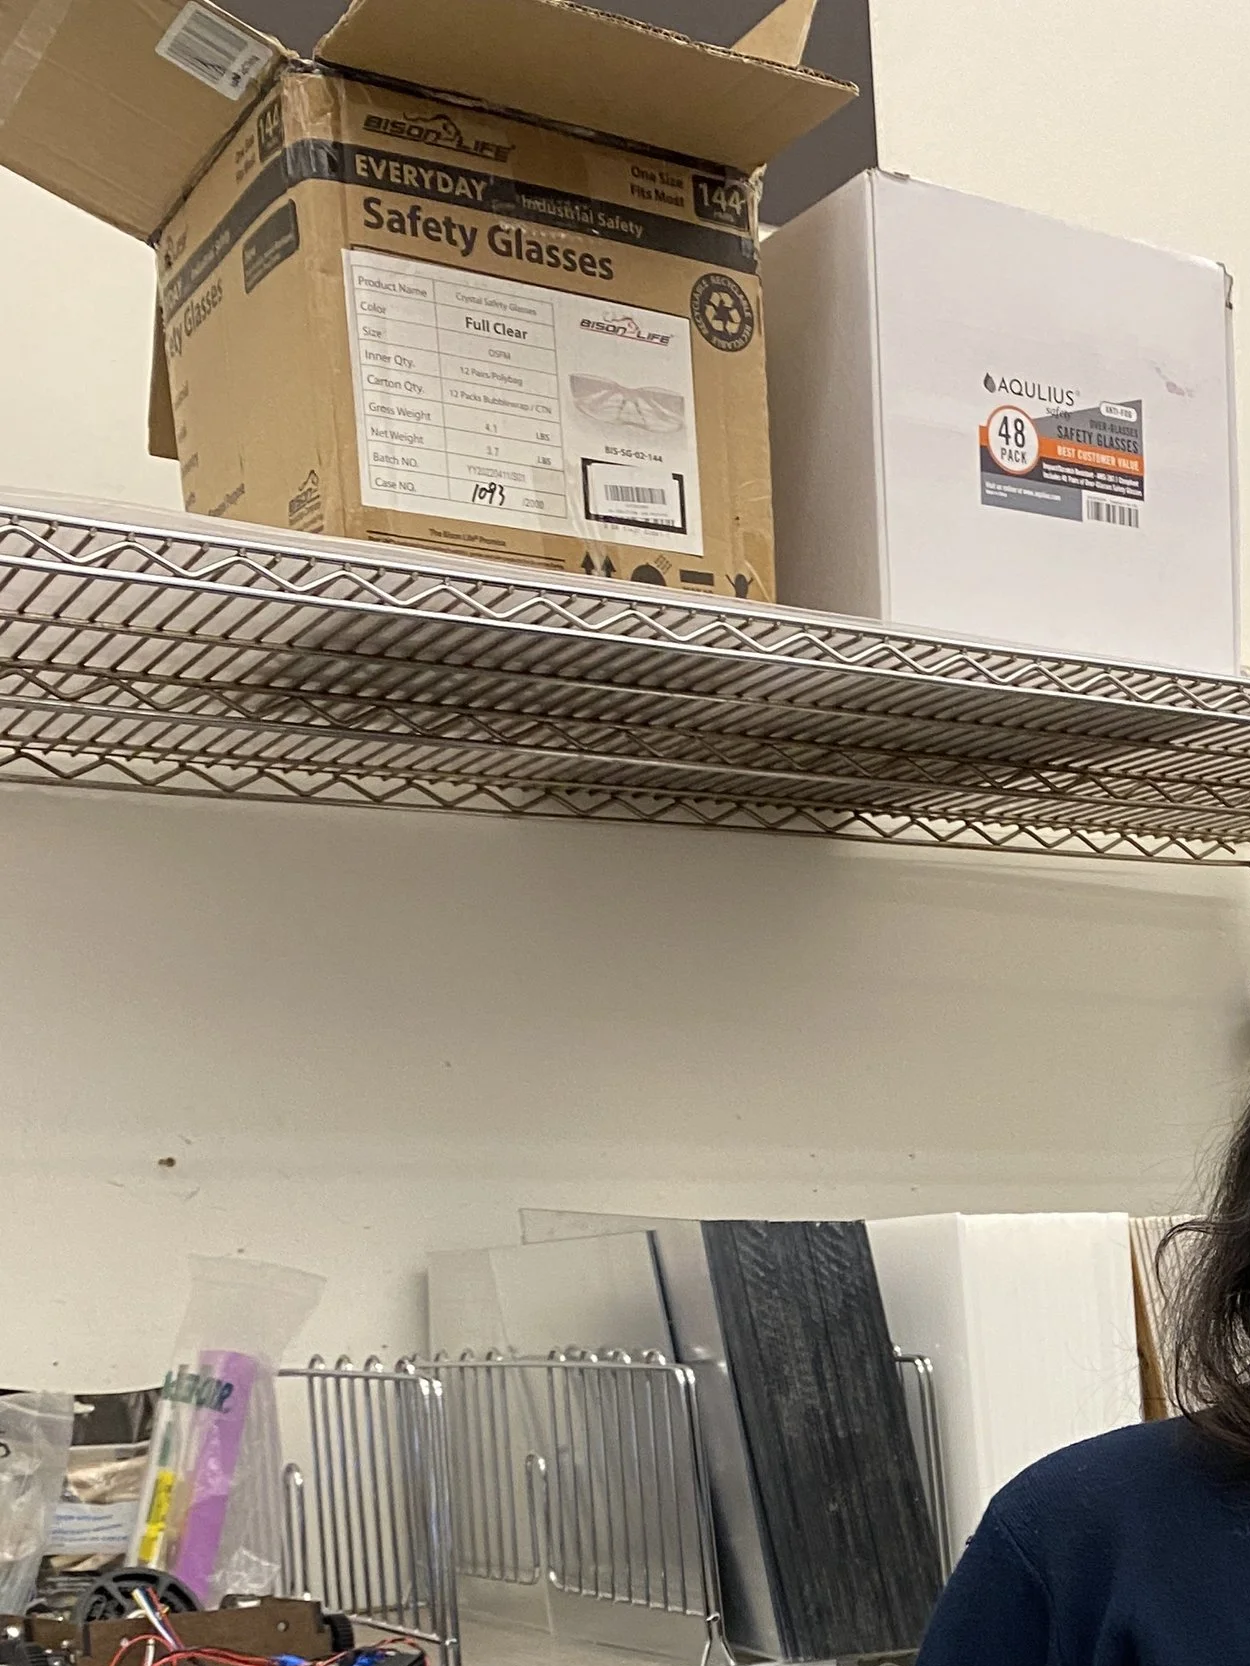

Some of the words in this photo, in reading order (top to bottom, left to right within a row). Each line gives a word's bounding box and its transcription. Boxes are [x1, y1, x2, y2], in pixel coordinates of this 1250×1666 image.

[355, 153, 488, 200] EVERYDAY
[630, 166, 656, 184] One
[658, 171, 684, 189] Size
[630, 183, 654, 199] Fits
[655, 187, 685, 208] Most
[699, 183, 746, 215] 144
[521, 194, 594, 224] Industrial
[600, 212, 643, 239] Safety
[363, 196, 478, 257] Safety
[488, 224, 614, 281] Glasses
[358, 276, 397, 292] Product
[399, 284, 428, 298] Name
[184, 277, 224, 337] Glasses
[360, 301, 387, 315] Color
[363, 326, 382, 339] Size
[465, 316, 490, 333] Full
[494, 323, 528, 340] Clear
[580, 318, 627, 336] BISON
[364, 350, 391, 365] Inner
[394, 355, 415, 369] Qty.
[460, 366, 470, 376] 12
[367, 374, 402, 391] Carton
[404, 381, 425, 395] Qty.
[998, 376, 1075, 407] AQULIUS
[369, 402, 395, 416] Gross
[397, 404, 431, 422] Weight
[371, 426, 389, 438] Net
[391, 428, 424, 445] Weight
[998, 415, 1026, 449] 48
[1057, 425, 1093, 446] SAFETY
[1097, 433, 1139, 454] GLASSES
[373, 451, 399, 466] Batch
[1000, 447, 1028, 464] PACK
[1057, 445, 1076, 458] BEST
[1077, 449, 1116, 467] CUSTOMER
[1118, 457, 1140, 472] VALUE
[375, 476, 397, 490] Case
[472, 482, 506, 506] 1093
